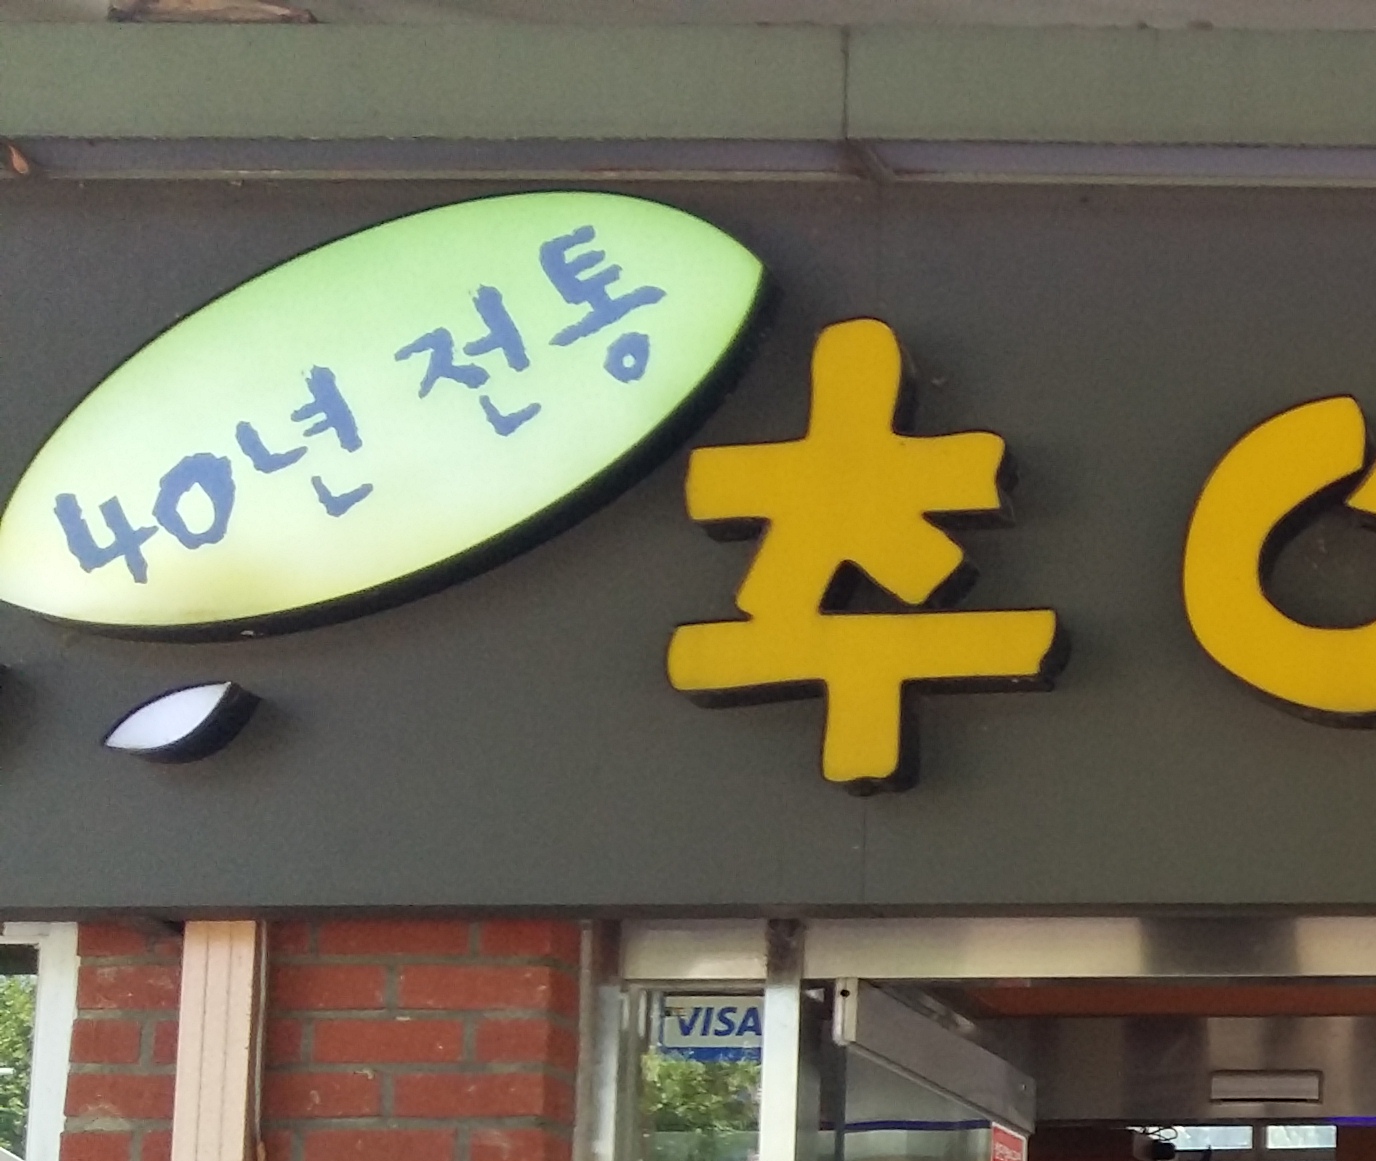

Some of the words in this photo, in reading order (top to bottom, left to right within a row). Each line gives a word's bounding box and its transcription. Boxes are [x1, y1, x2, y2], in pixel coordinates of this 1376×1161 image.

[53, 365, 373, 584] 40년
[393, 224, 666, 437] 전통
[678, 1006, 763, 1037] VISA
